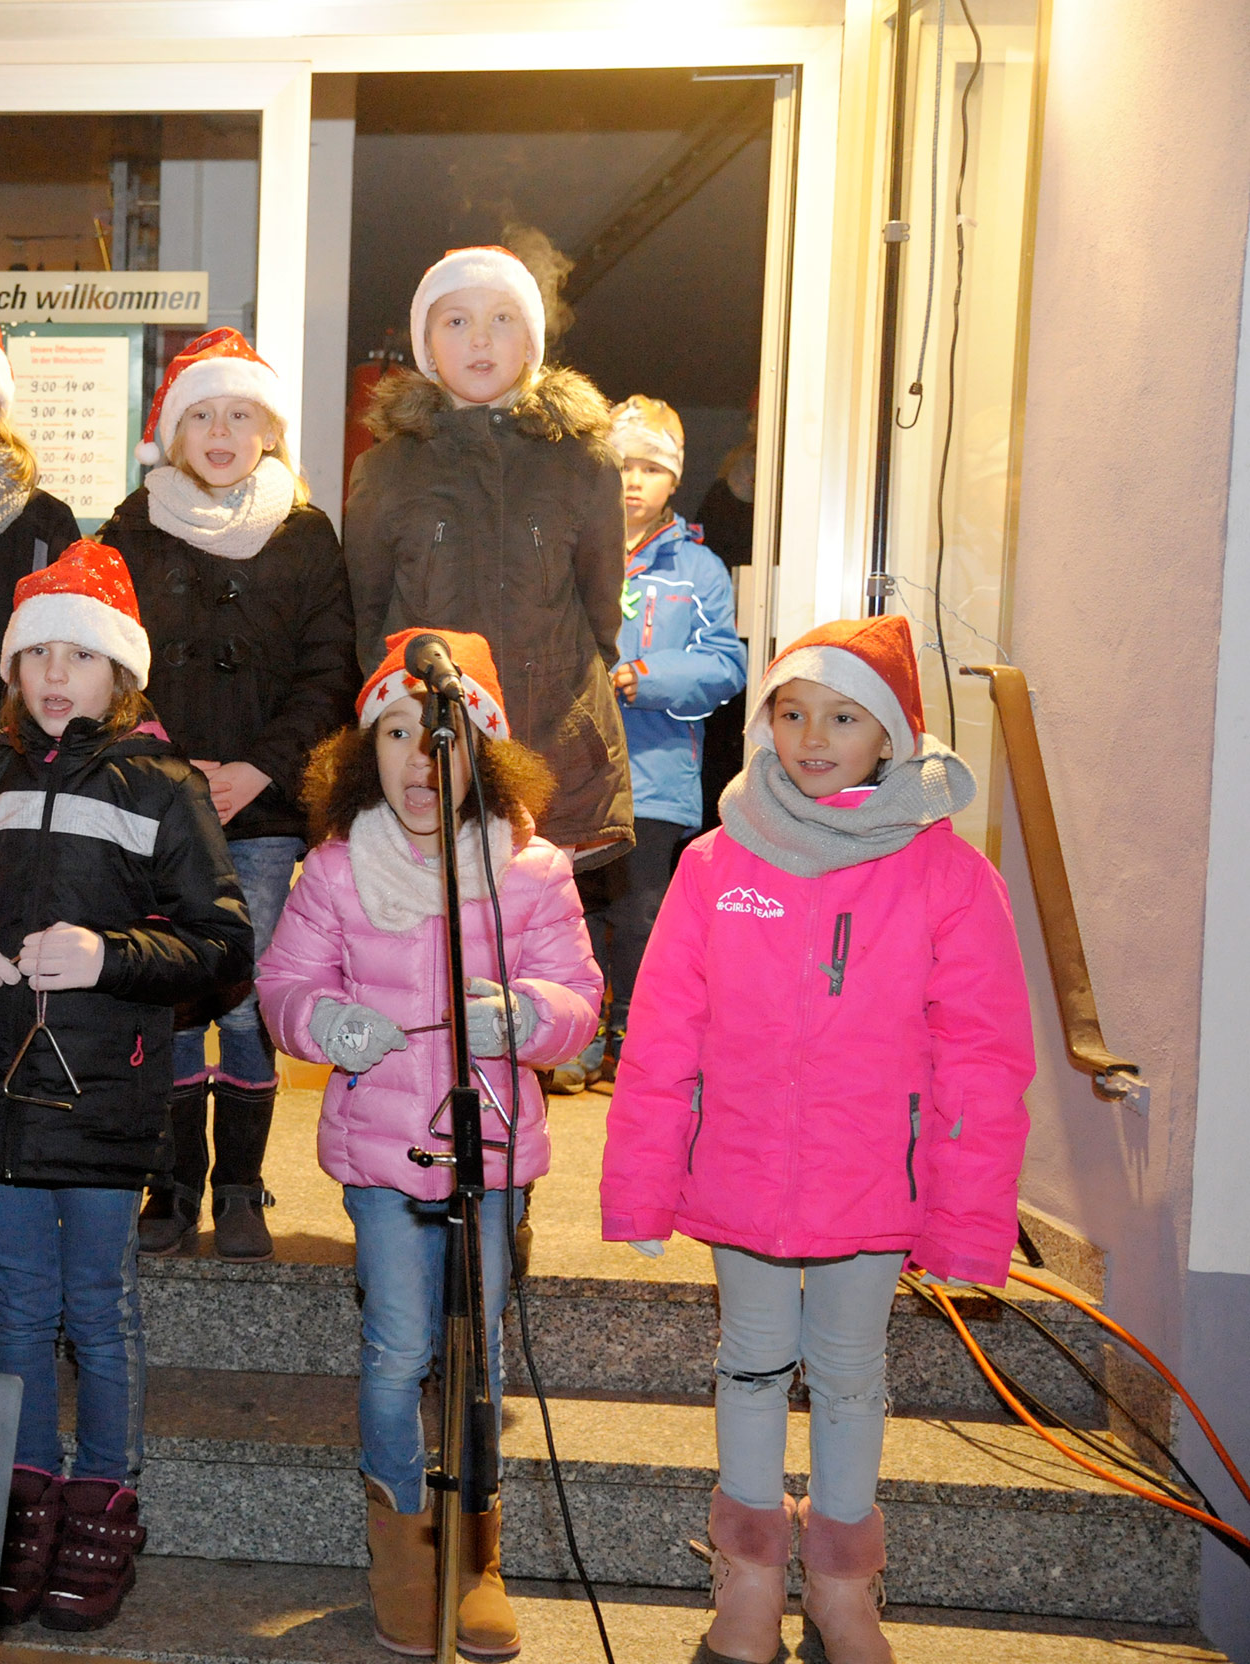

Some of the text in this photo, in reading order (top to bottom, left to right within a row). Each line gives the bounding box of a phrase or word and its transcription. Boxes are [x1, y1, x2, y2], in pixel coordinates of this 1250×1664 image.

[37, 284, 200, 311] willkommen
[725, 902, 777, 919] GIRLS TEAM
